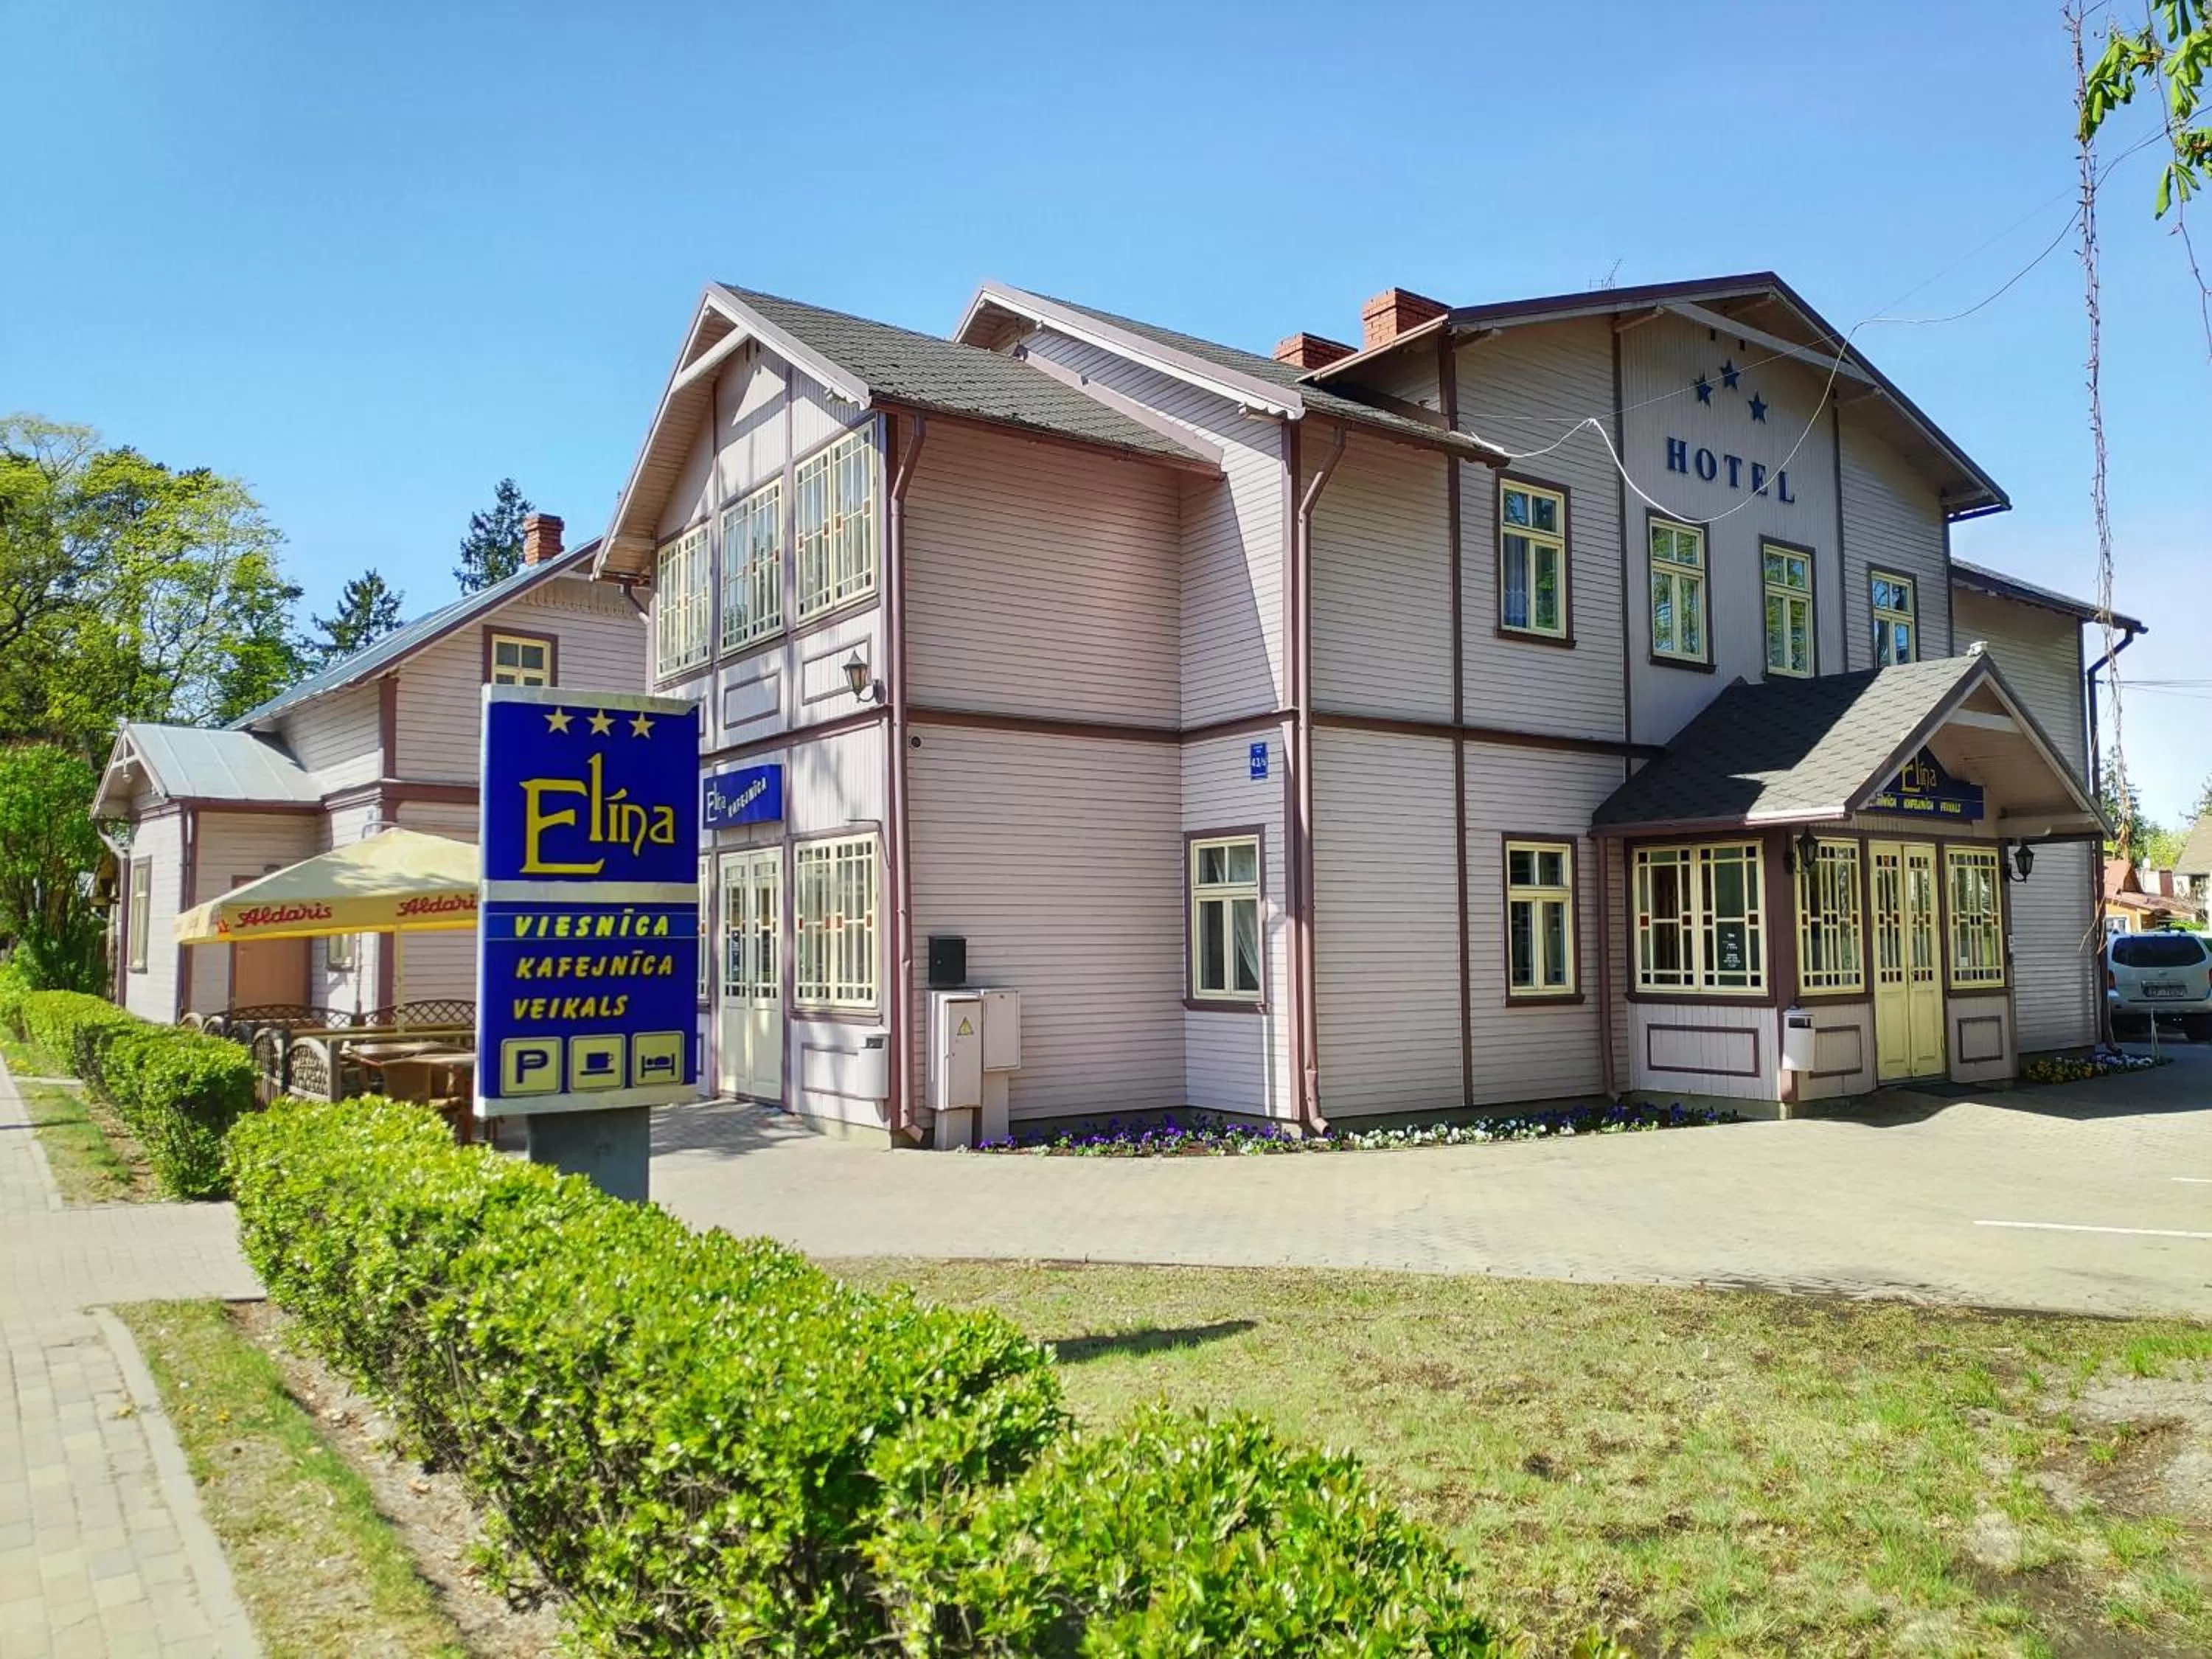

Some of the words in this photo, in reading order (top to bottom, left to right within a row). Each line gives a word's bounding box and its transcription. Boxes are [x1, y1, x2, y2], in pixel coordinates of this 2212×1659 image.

[1666, 437, 1795, 504] HOTEL
[234, 902, 333, 928] Aldaris
[397, 893, 476, 916] Aldari
[515, 908, 669, 937] VIESNĪCA
[516, 950, 673, 979] KAFEJNĪCA
[513, 995, 628, 1020] VEIKALS
[516, 1049, 549, 1084] P
